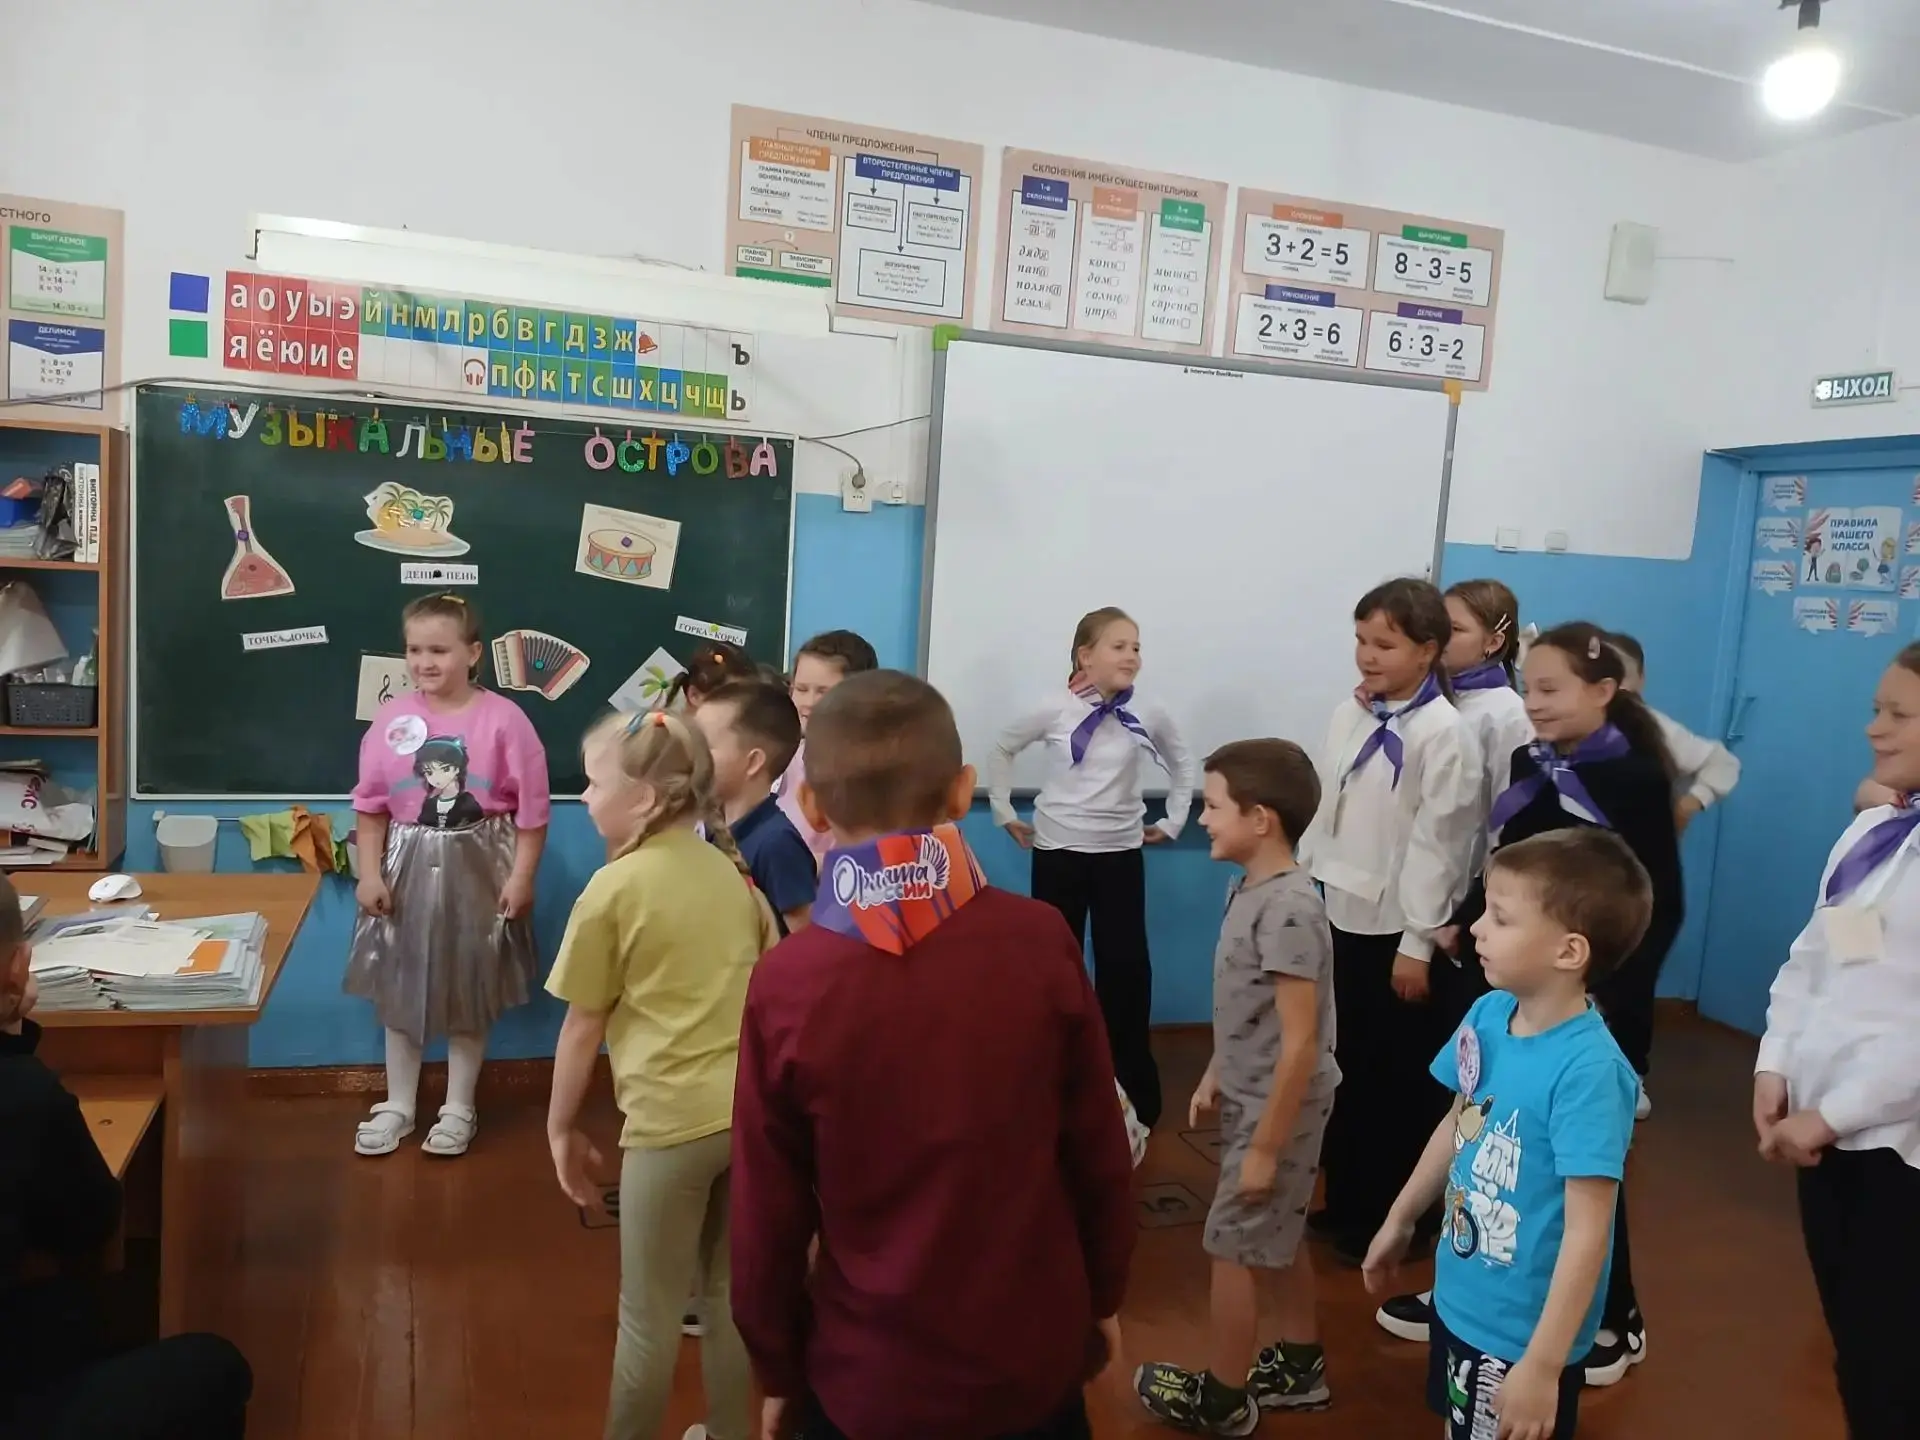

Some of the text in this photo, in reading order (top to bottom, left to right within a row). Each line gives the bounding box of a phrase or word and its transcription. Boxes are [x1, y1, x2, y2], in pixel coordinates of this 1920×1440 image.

[806, 129, 915, 154] ЧЛЕНЫ ПРЕДЛОЖЕНИЯ
[758, 150, 816, 166] ПРЕДЛОЖЕНИЯ
[863, 156, 954, 178] ВТОРОСТЕПЕННЫЕ ЧЛЕНЫ
[881, 168, 935, 186] ПРЕДЛОЖЕНИЯ
[1032, 162, 1086, 180] СКЛОНЕНИЯ
[1114, 176, 1200, 199] СУЩЕСТВИТЕЛЬНЫХ
[1266, 232, 1348, 266] 3 + 2 = 5
[1394, 252, 1408, 274] 8
[1429, 258, 1442, 279] 3
[1446, 266, 1456, 276] =
[1459, 262, 1472, 283] 5
[230, 284, 248, 308] а
[1086, 290, 1128, 304] солн
[1154, 284, 1182, 294] ноч
[38, 326, 78, 336] ДЕЛИМОЕ
[1259, 314, 1272, 337] 2
[1293, 318, 1307, 340] 3
[1313, 328, 1324, 336] =
[1328, 322, 1340, 344] 6
[229, 329, 354, 370] я ё ю и е
[1389, 330, 1402, 352] 6
[1420, 334, 1434, 356] 3
[1438, 343, 1449, 352] =
[1452, 338, 1464, 360] 2
[1816, 376, 1890, 400] ВЫХОД
[180, 401, 778, 478] МУЗЫКАЛЬНЫЕ ОСТРОВА
[1830, 518, 1878, 528] ПРАВИЛА
[90, 526, 98, 545] ПДД
[1831, 530, 1874, 540] НАШЕГО
[1832, 542, 1870, 551] КЛАССА
[404, 570, 477, 581] ДЕН ПЕНЬ
[248, 634, 284, 646] ТОЧКА
[678, 622, 708, 636] ГОРКА
[714, 632, 744, 645] КОРКА
[1472, 1130, 1522, 1192] BORN
[1470, 1190, 1519, 1264] RIDE
